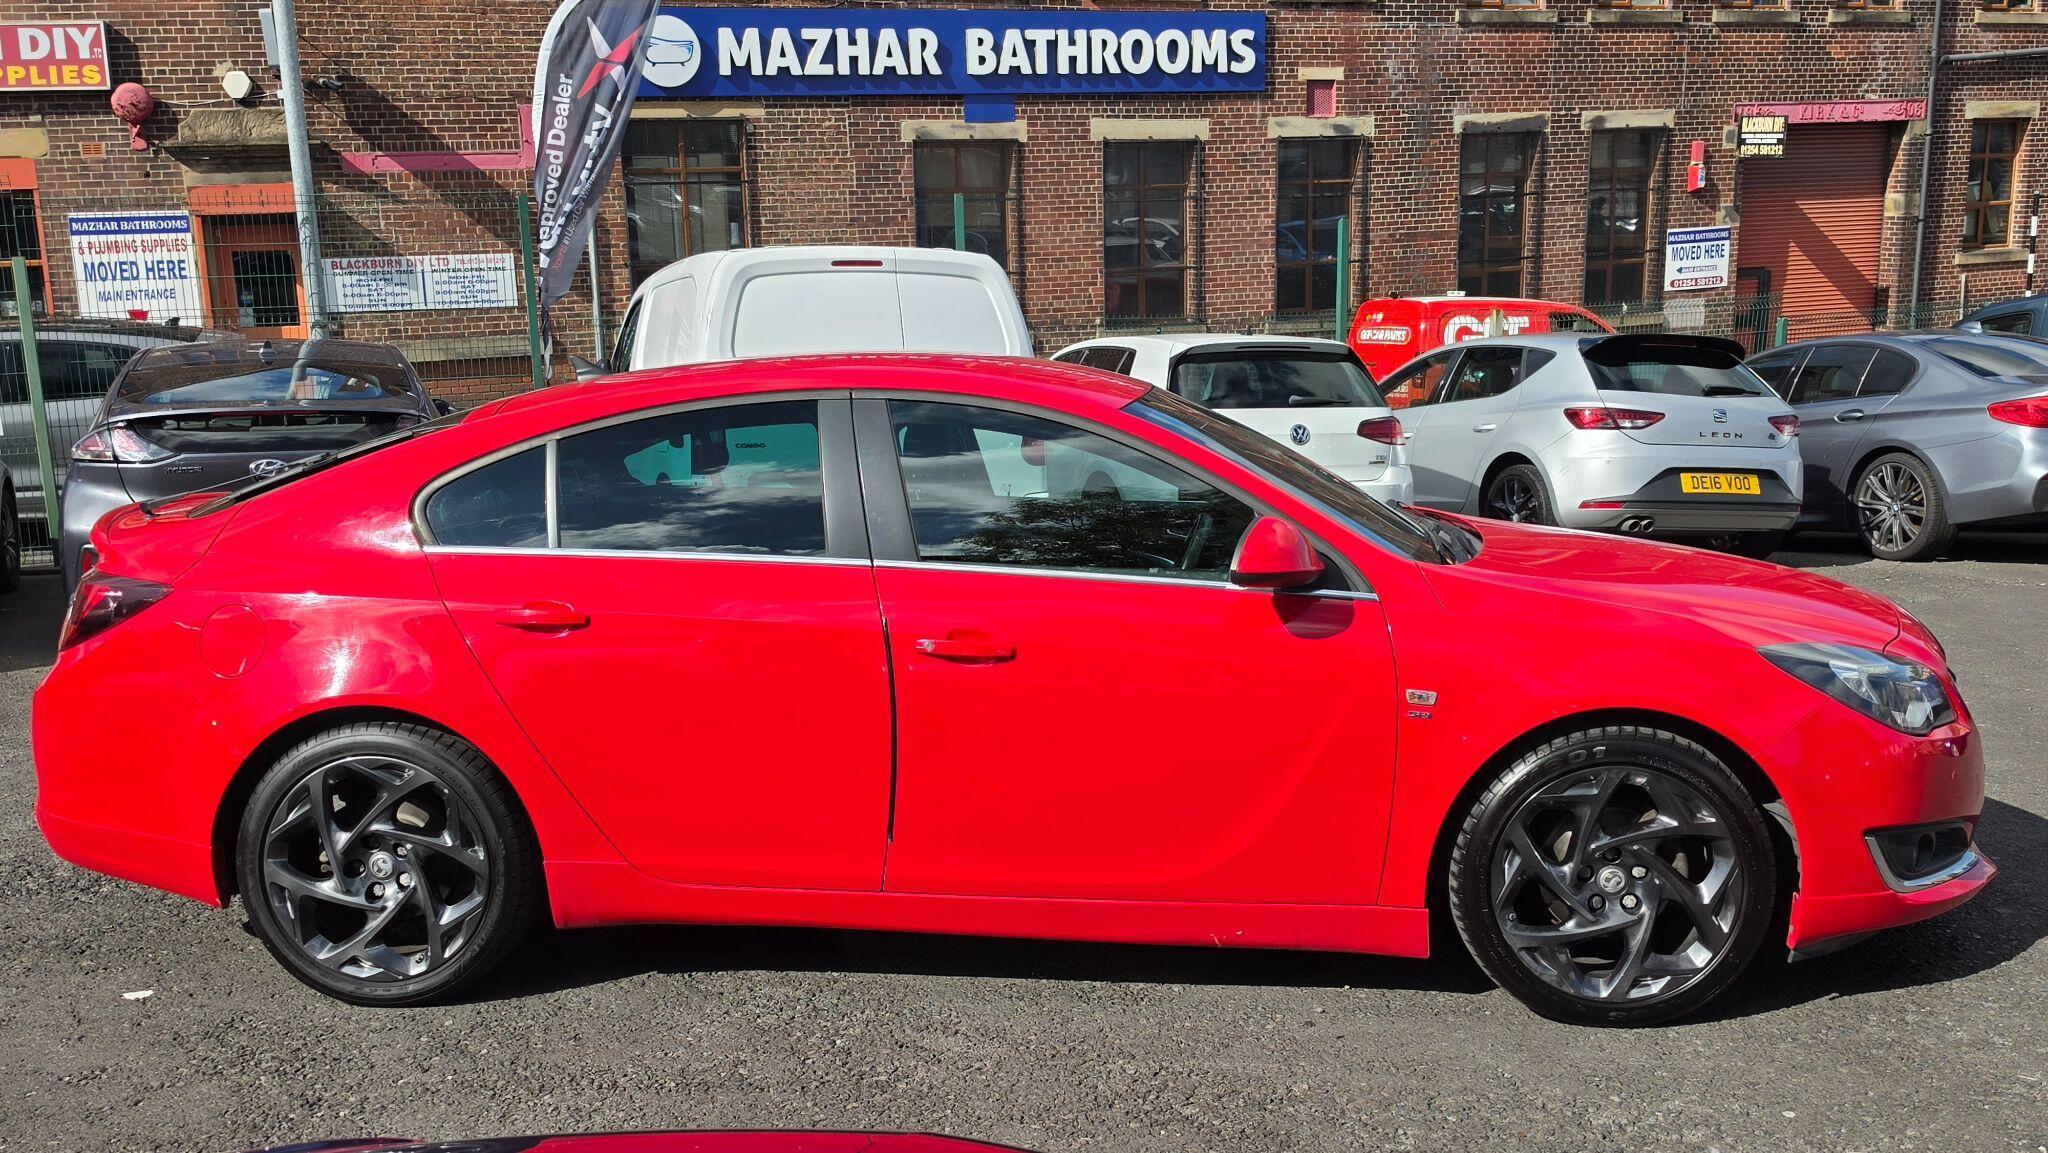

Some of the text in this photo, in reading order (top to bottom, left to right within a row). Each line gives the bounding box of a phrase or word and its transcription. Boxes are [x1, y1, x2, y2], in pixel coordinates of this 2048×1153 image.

[17, 27, 97, 60] DIY
[718, 27, 1256, 76] MAZHAR BATHROOMS
[0, 65, 102, 85] PLIES
[547, 73, 573, 146] Dealer
[1800, 104, 1835, 120] KIRK
[1741, 145, 1783, 155] 01254 581212
[71, 219, 188, 231] MAZHAR BATHROOMS
[78, 238, 187, 256] & PLUMBING SUPPLIES
[1671, 243, 1726, 262] MOVED HERE
[83, 259, 188, 283] MOVED HERE
[331, 258, 403, 270] BLACKBURN
[430, 257, 450, 267] LTD
[1673, 279, 1696, 288] 01254
[98, 288, 177, 303] MAIN ENTRANCE
[1699, 431, 1743, 439] LEON
[1690, 475, 1722, 490] DE16
